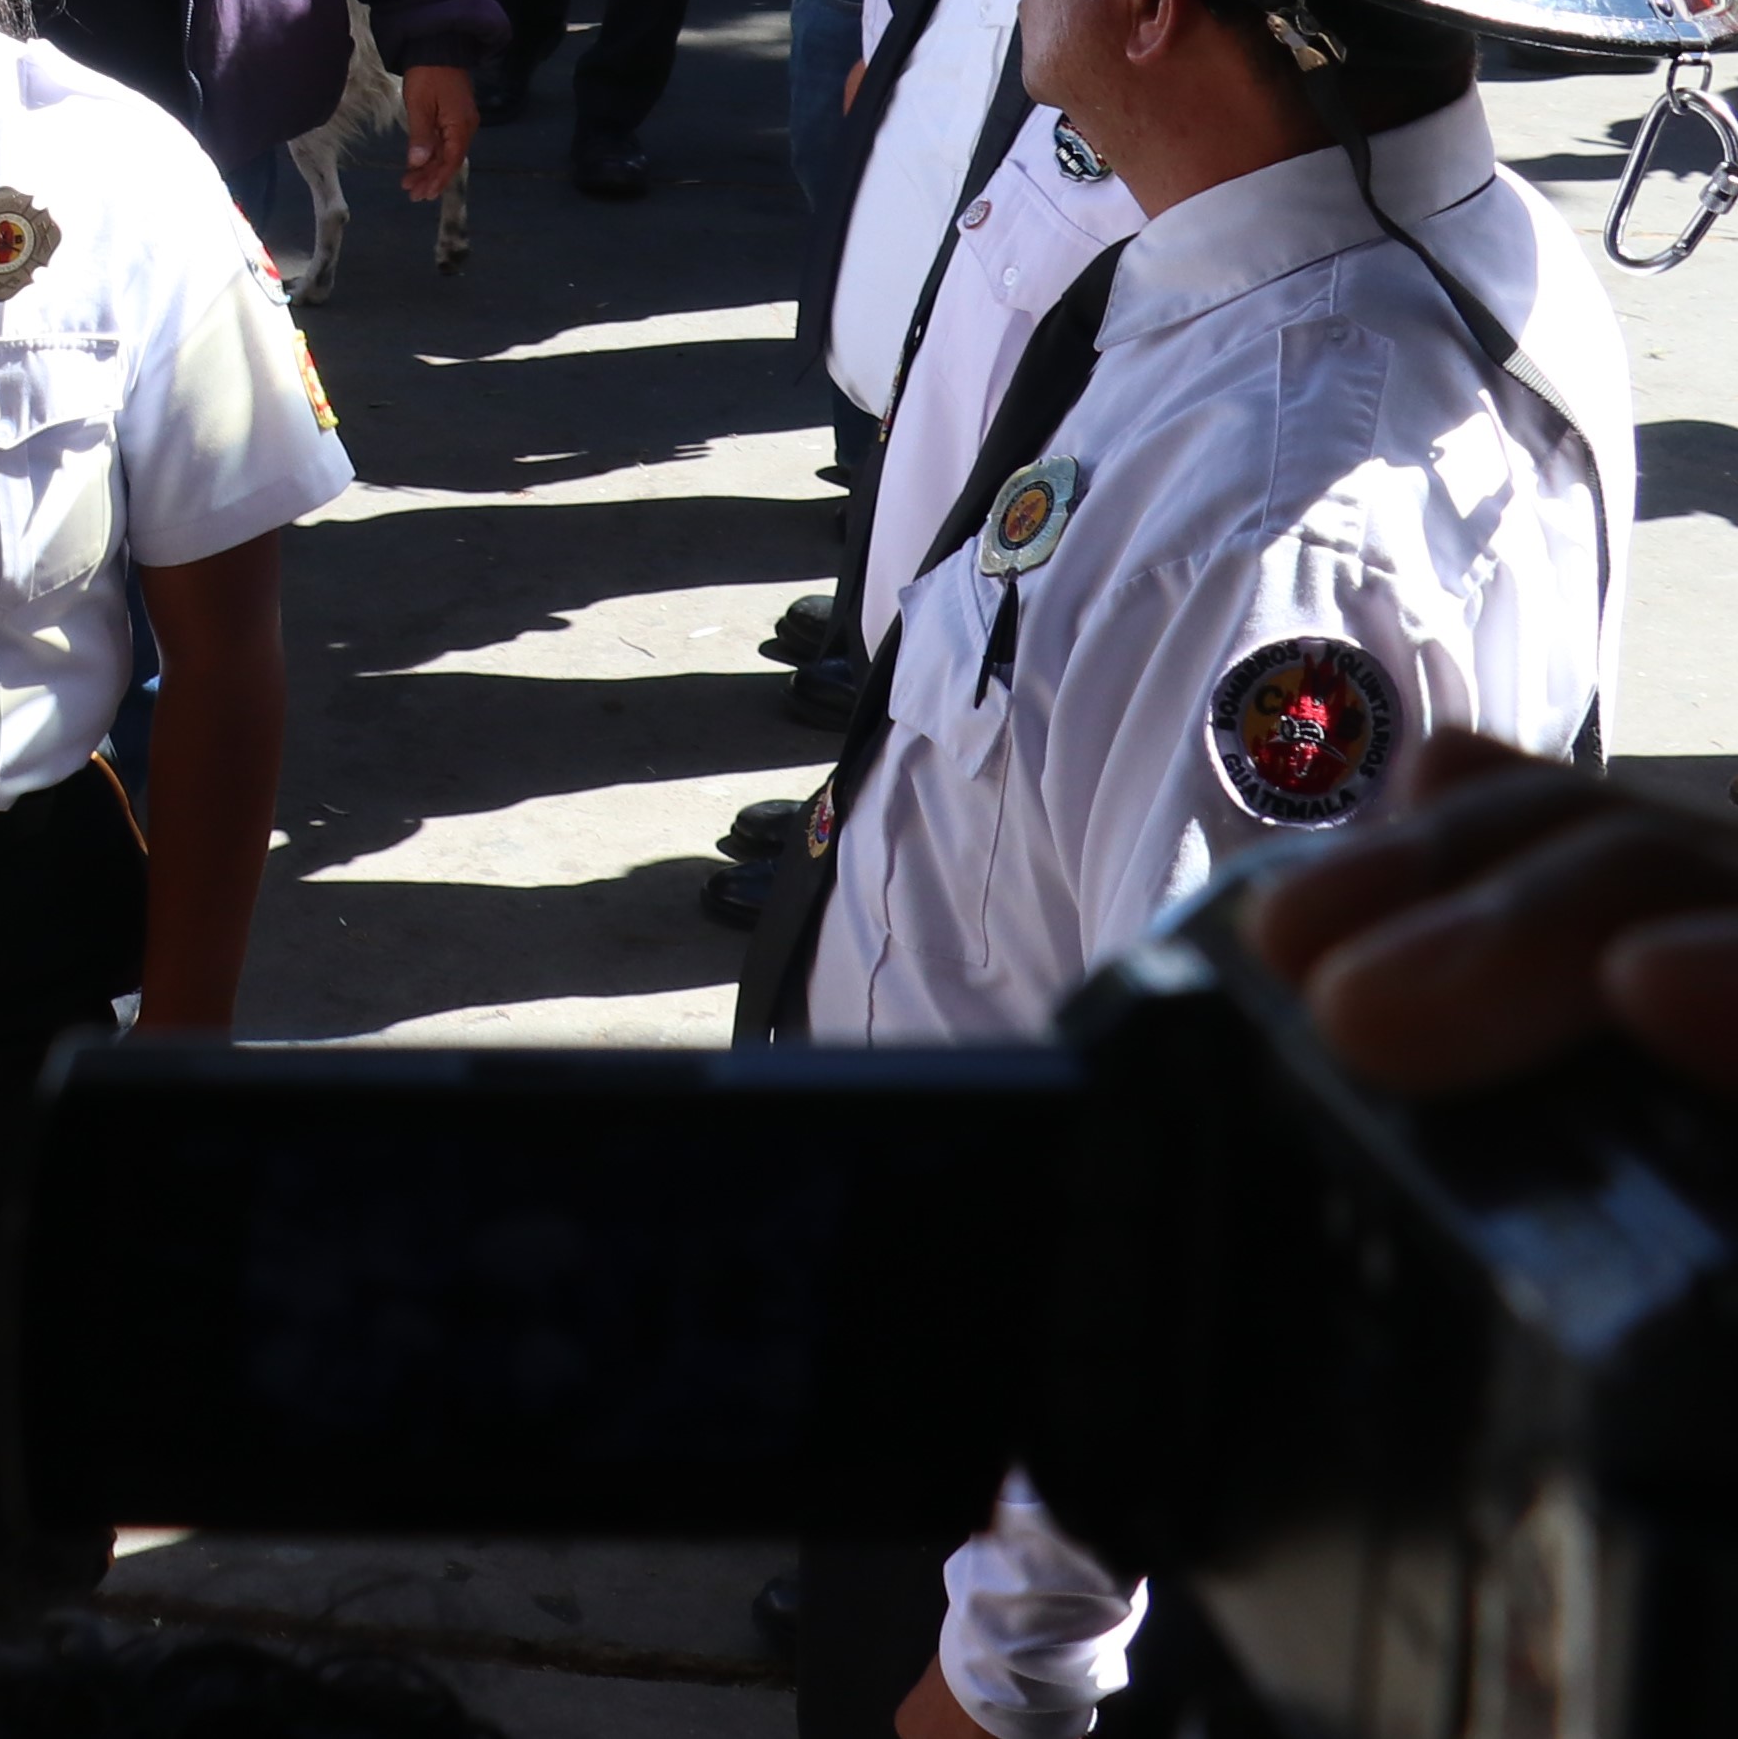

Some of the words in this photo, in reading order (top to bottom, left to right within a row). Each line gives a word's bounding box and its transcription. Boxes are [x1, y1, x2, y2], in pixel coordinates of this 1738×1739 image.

[1218, 645, 1304, 732] BOMBEROS
[1323, 646, 1391, 780] VOLUNTARIOS
[1222, 752, 1356, 819] GUATEMALA
